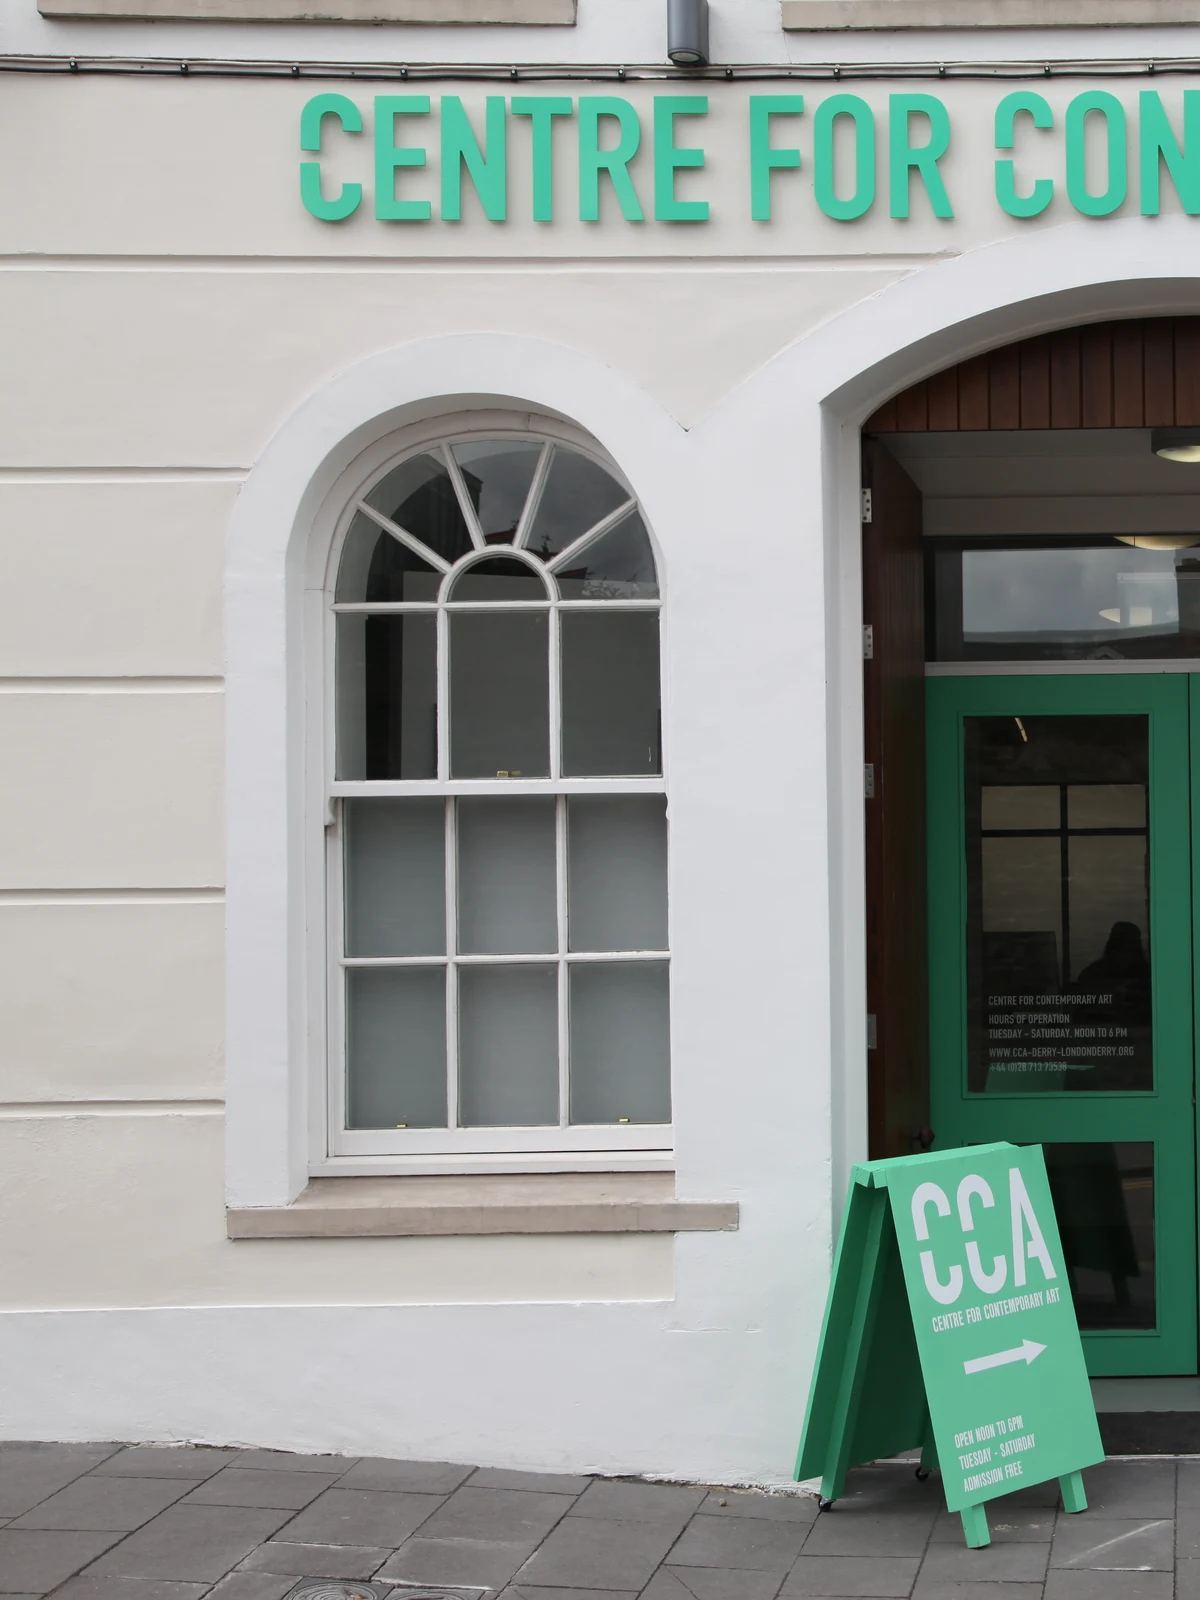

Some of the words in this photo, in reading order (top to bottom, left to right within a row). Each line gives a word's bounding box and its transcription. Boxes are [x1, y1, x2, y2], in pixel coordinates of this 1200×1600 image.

[300, 93, 710, 222] CENTRE
[749, 93, 955, 221] FOR
[988, 995, 1017, 1006] CENTRE
[1018, 995, 1034, 1005] FOR
[1035, 994, 1097, 1005] CONTEMPORARY
[1098, 994, 1113, 1004] ART
[988, 1014, 1015, 1025] HOURS
[1016, 1014, 1027, 1024] OF
[1028, 1013, 1070, 1024] OPERATION
[989, 1029, 1022, 1039] TUESDAY
[1074, 1027, 1096, 1038] NOON
[1098, 1027, 1108, 1038] TO
[1108, 1027, 1114, 1037] 6
[1115, 1027, 1128, 1037] PM
[989, 1046, 1134, 1058] WWW.CCA-DERRY-LONDONDERRY.ORG
[990, 1062, 1006, 1072] +44
[1007, 1062, 1027, 1072] (0)28
[1028, 1061, 1043, 1071] 713
[911, 1167, 1057, 1305] CCA
[932, 1311, 965, 1333] CENTRE
[966, 1306, 982, 1325] FOR
[983, 1291, 1043, 1320] CONTEMPORARY
[1046, 1287, 1061, 1305] ART
[954, 1429, 975, 1449] OPEN
[975, 1423, 996, 1443] NOON
[996, 1420, 1007, 1436] TO
[1007, 1415, 1024, 1432] 6PM
[958, 1447, 993, 1471] TUESDAY
[1000, 1433, 1036, 1458] SATURDAY
[963, 1466, 1004, 1493] ADMISSION
[1004, 1460, 1024, 1479] FREE
